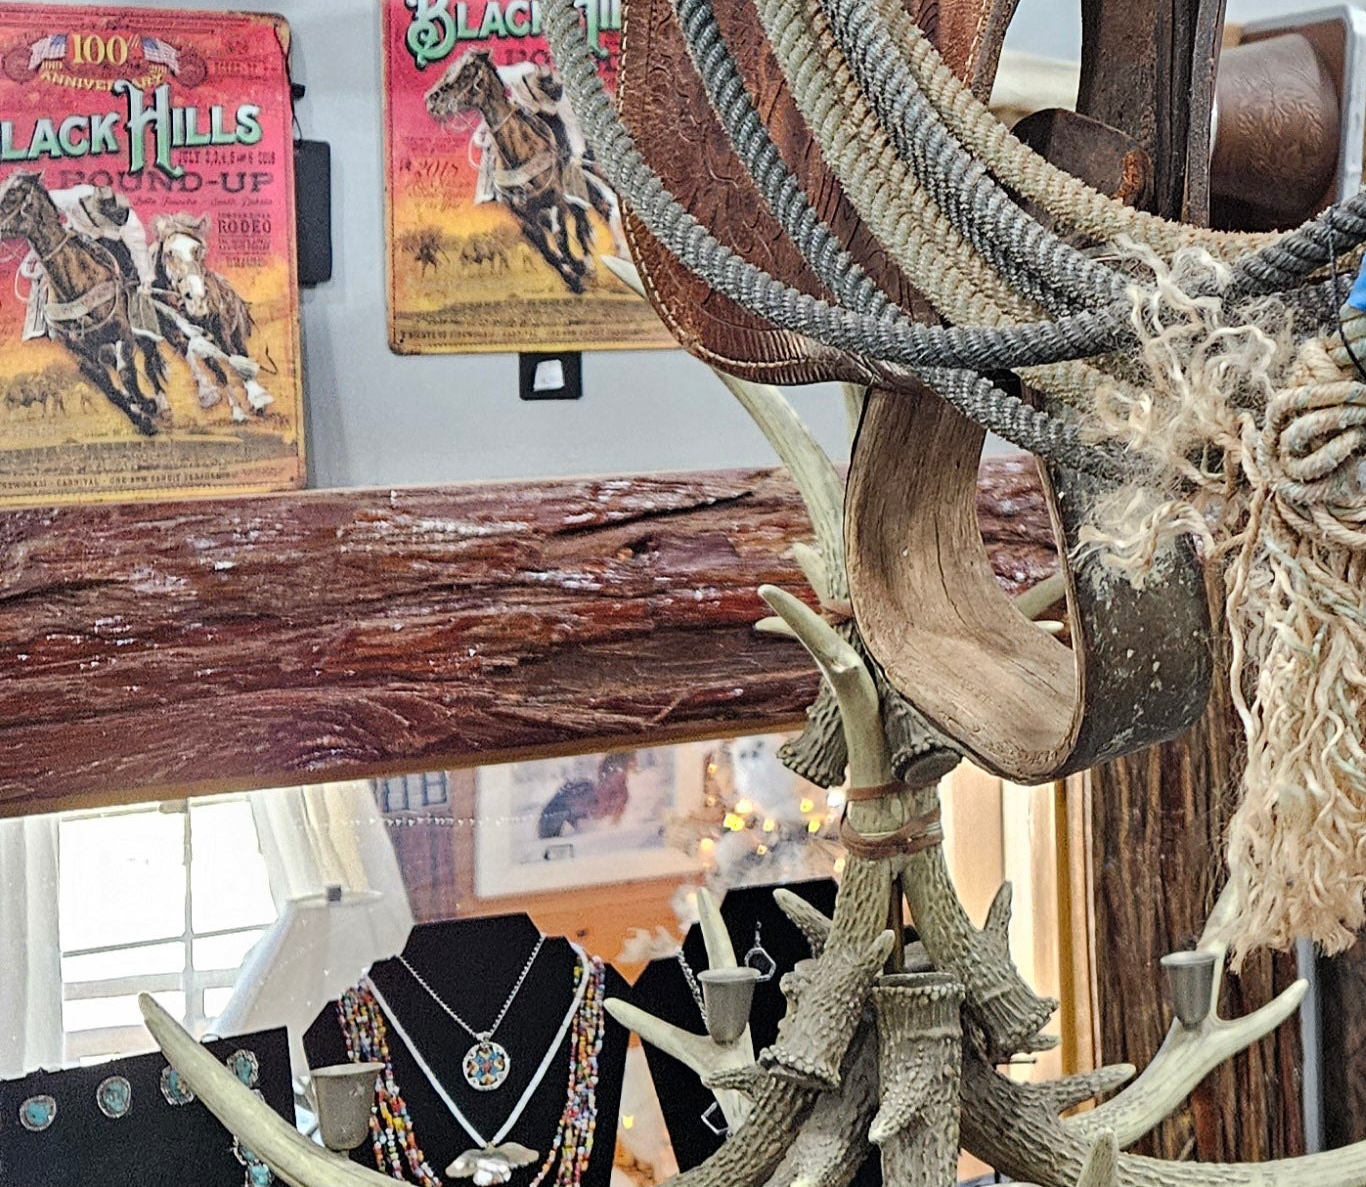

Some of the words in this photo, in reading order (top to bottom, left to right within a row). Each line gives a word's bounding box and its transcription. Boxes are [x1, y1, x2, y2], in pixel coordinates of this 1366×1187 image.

[40, 70, 167, 91] ANNIVEARY
[111, 78, 263, 179] HILLS
[217, 219, 272, 235] RODEO
